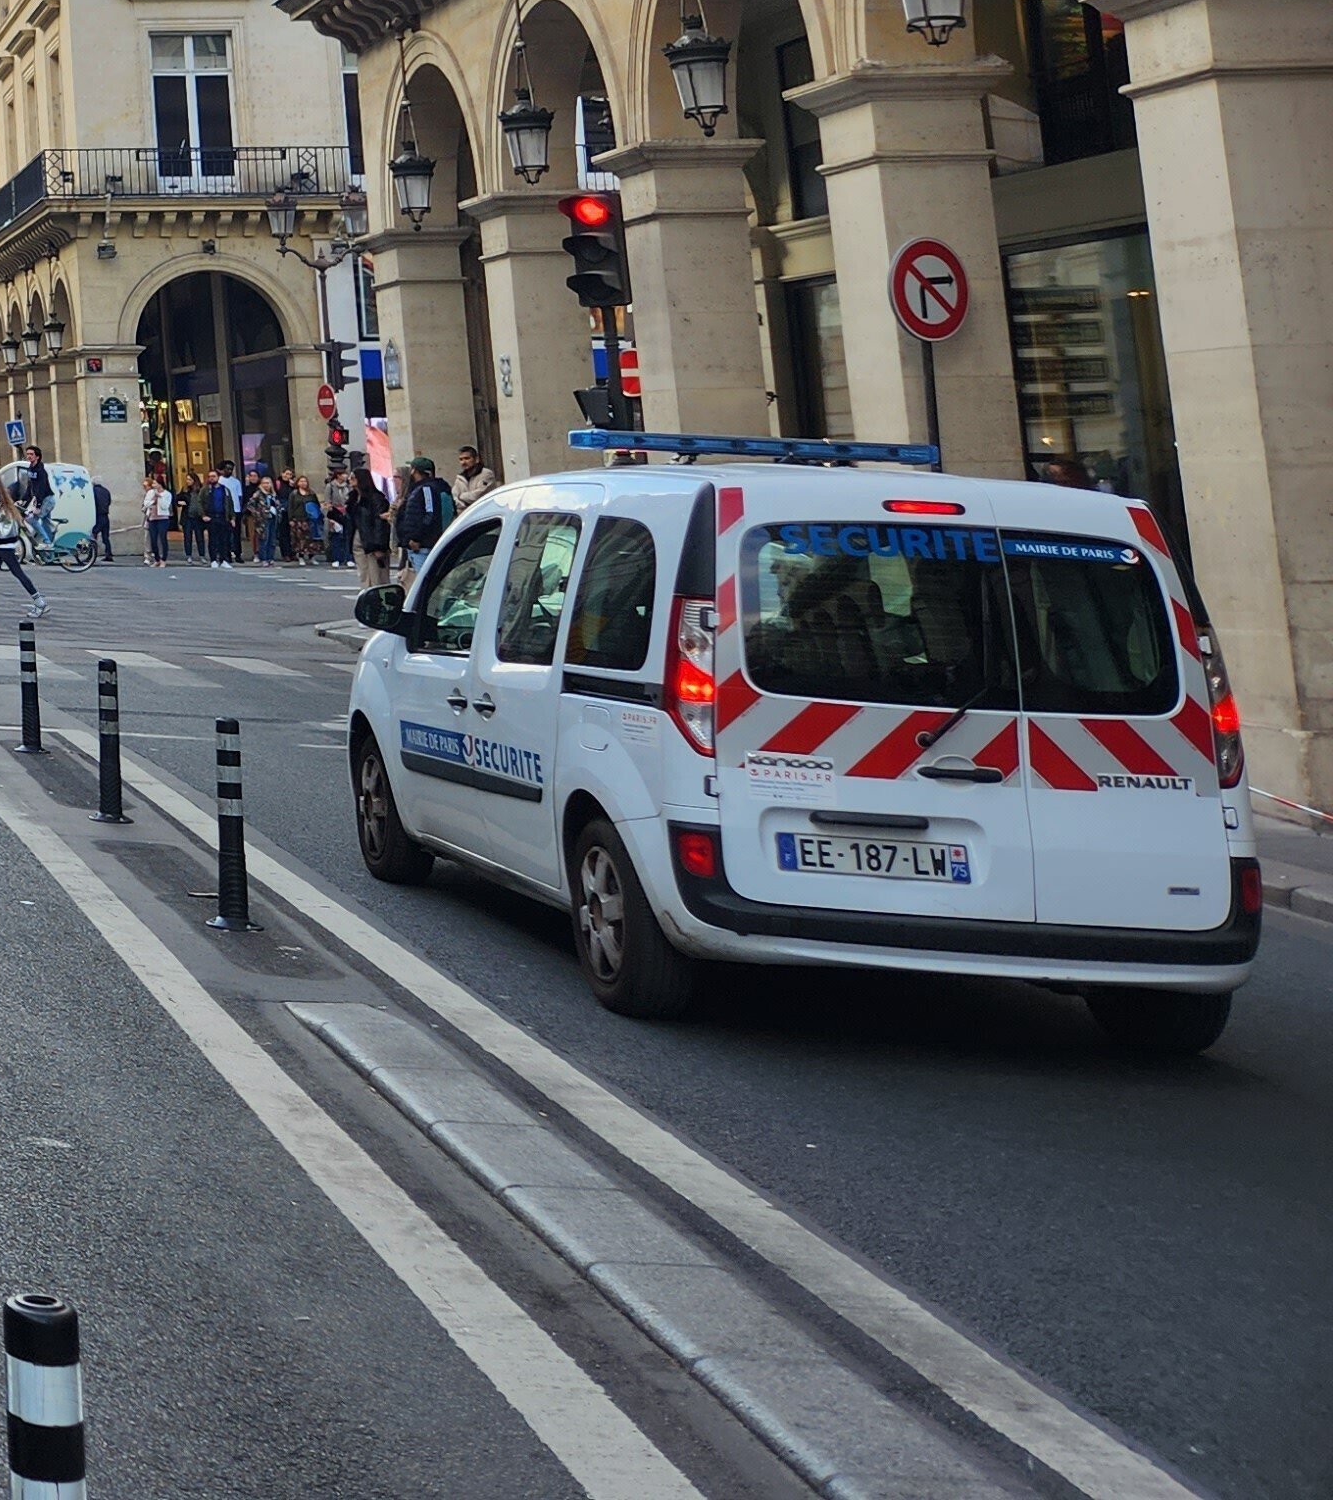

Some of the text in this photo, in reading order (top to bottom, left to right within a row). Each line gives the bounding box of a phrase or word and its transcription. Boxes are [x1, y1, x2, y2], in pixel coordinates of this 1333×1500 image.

[781, 524, 1001, 563] SECURITE
[1015, 543, 1115, 560] MAIRIE DE PARIS
[405, 728, 460, 756] MAIRIE DE PARIS
[474, 737, 544, 784] SECURITE
[763, 769, 832, 782] PARIS.FR
[1097, 775, 1193, 790] RENAULT
[799, 838, 946, 877] EE-187-LW
[951, 863, 968, 878] 75
